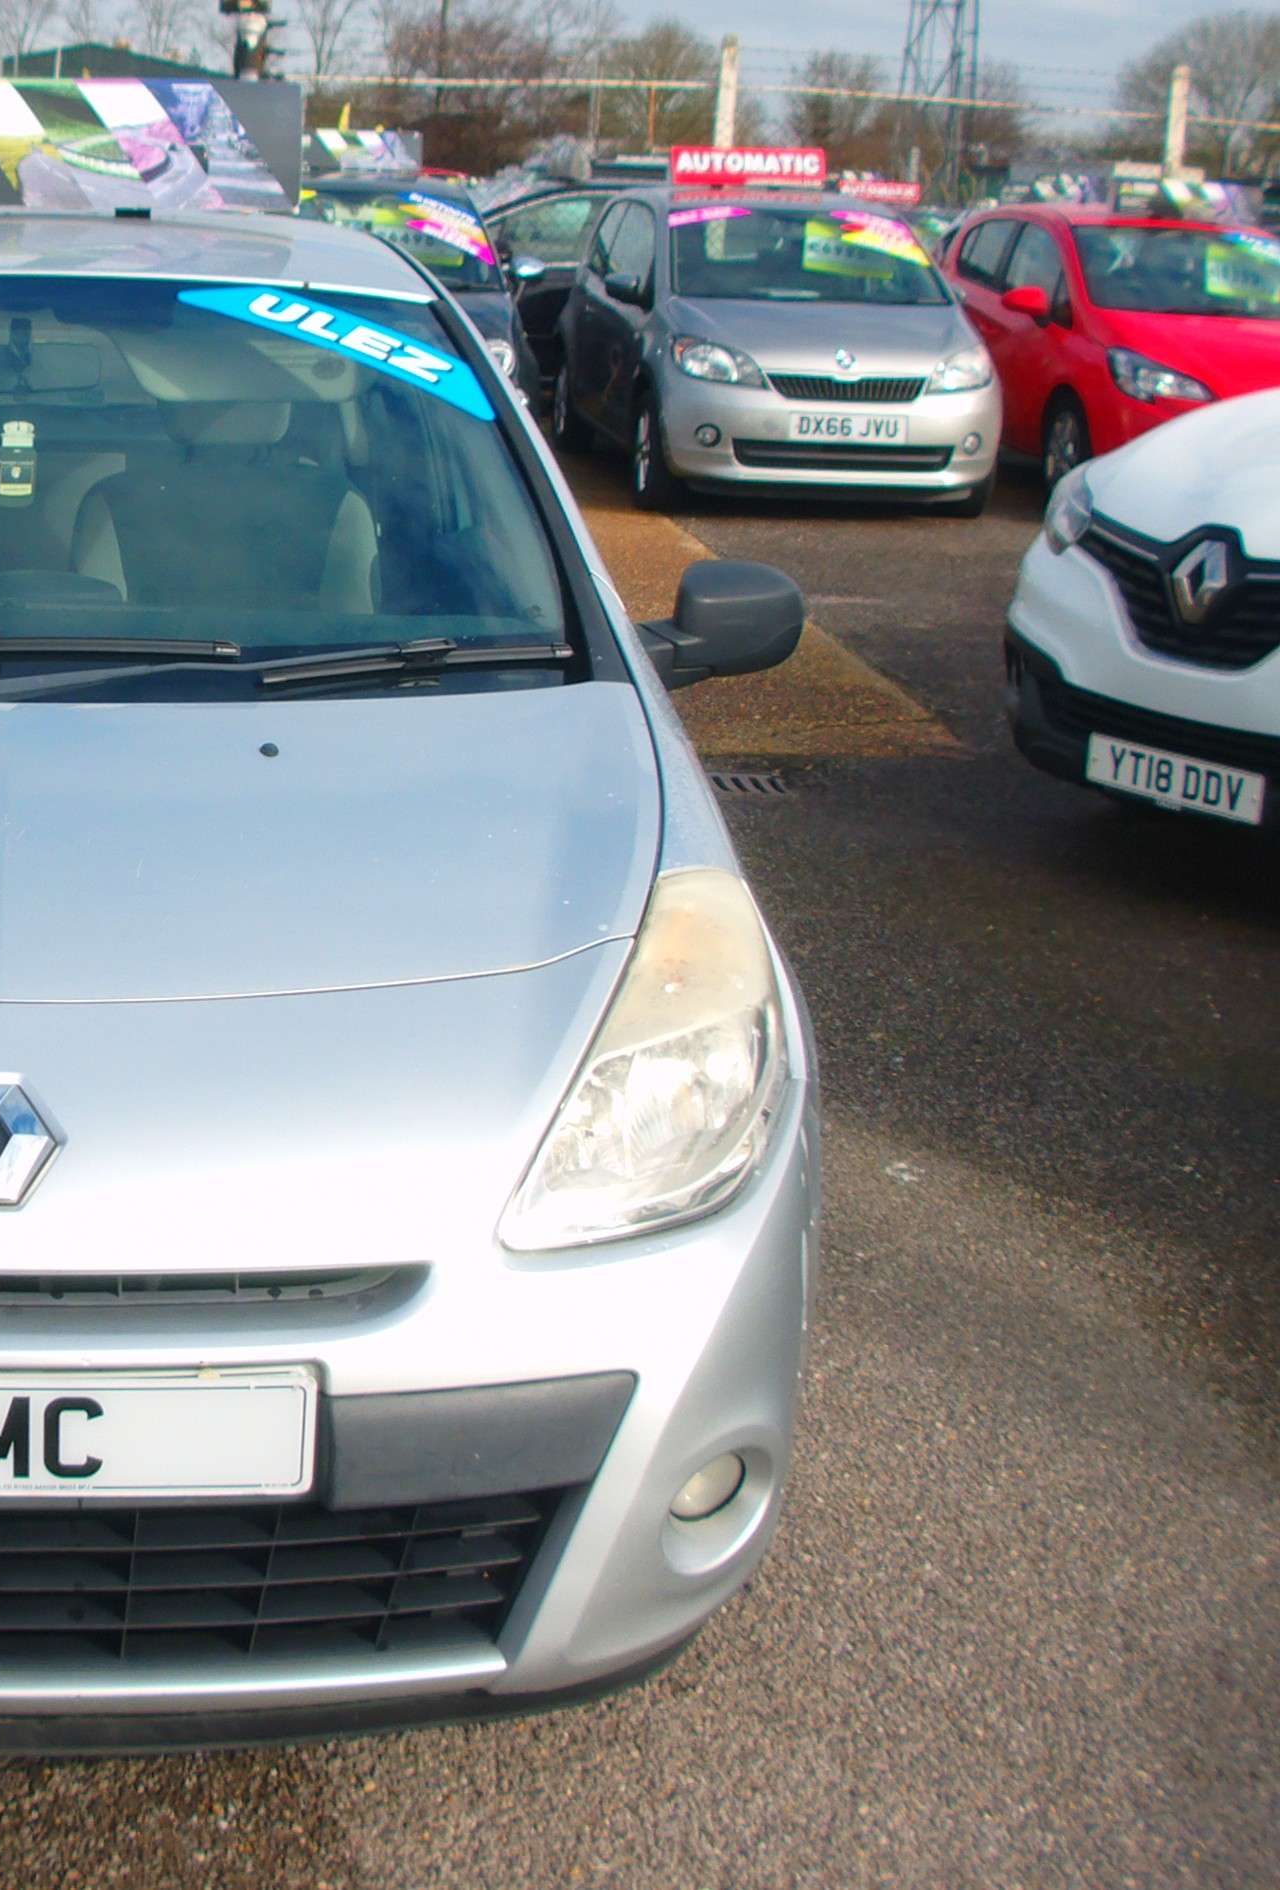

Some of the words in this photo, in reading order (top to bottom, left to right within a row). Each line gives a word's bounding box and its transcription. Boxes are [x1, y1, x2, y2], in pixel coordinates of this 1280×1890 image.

[676, 151, 820, 175] AUTOMATIC
[248, 293, 453, 383] ULEZ
[798, 416, 853, 436] DX66
[860, 418, 899, 438] JVU
[1110, 744, 1174, 793] YT18
[1182, 764, 1245, 811] DDV
